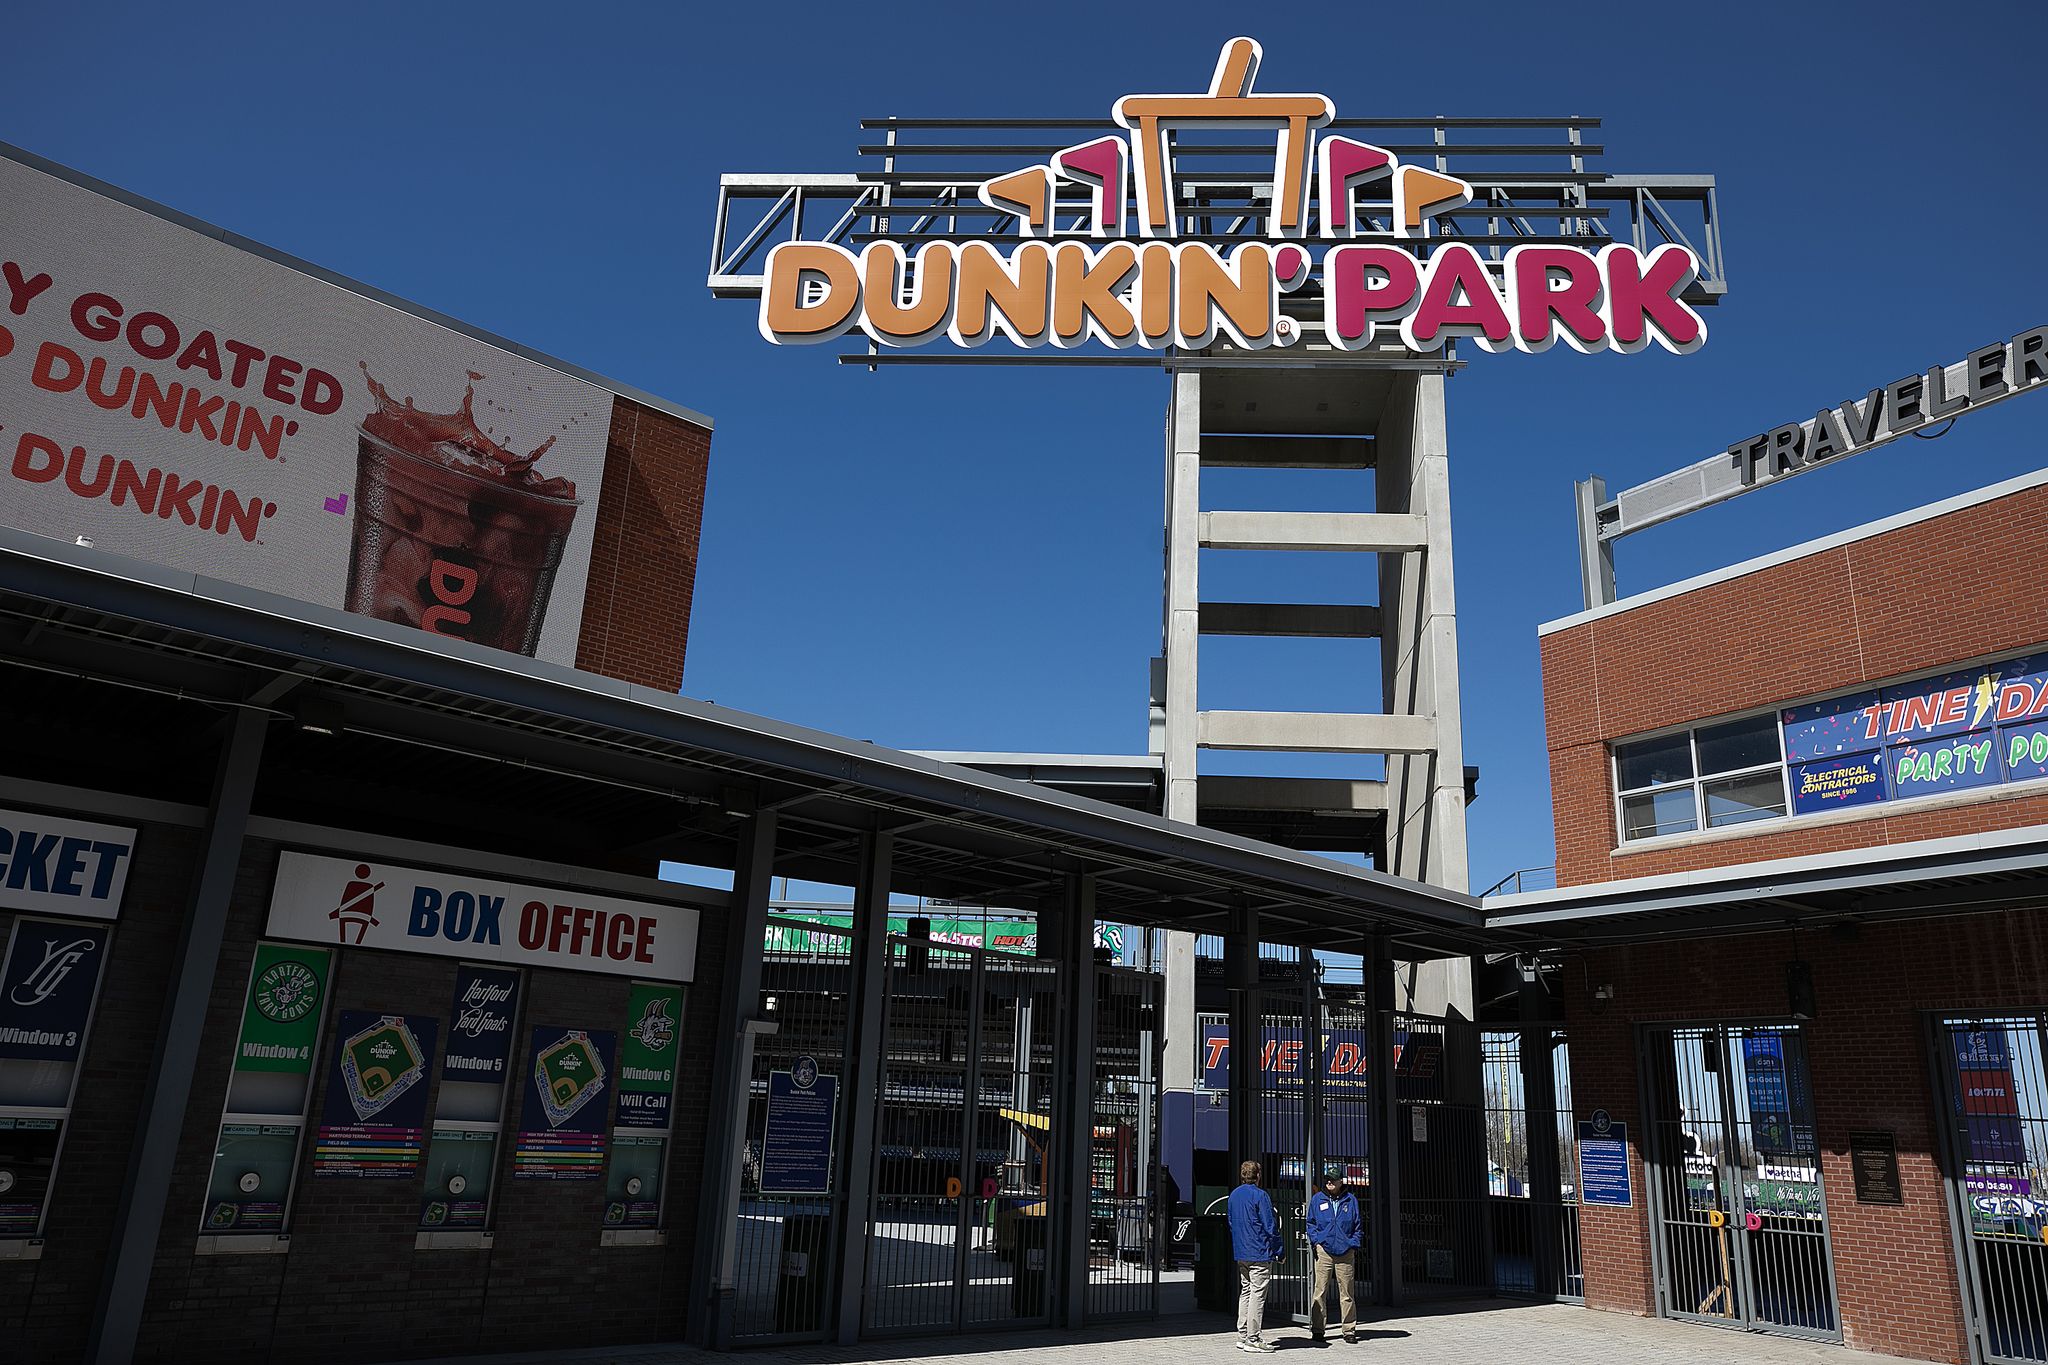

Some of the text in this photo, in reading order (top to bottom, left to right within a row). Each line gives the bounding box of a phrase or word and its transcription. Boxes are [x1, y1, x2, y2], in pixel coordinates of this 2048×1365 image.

[760, 239, 1708, 354] DUNKIN' PARK
[70, 292, 344, 415] GOATED
[31, 342, 300, 460] DUNKIN'
[1728, 325, 2048, 486] TRAVELER
[11, 432, 278, 543] DUNKIN'
[1863, 685, 1972, 739] TINE
[1896, 739, 1992, 785] PARTY
[1801, 773, 1877, 794] CONTRACTORS
[1806, 765, 1868, 783] ELECTRICAL
[1821, 790, 1841, 799] SINCE
[407, 885, 657, 963] BOX OFFICE
[993, 936, 1024, 946] HOT
[263, 964, 315, 988] HARTFORD
[461, 978, 514, 1008] Hartford
[258, 991, 314, 1019] YARD GOATS
[452, 1008, 483, 1031] Yard
[0, 1026, 77, 1047] Window 3
[242, 1042, 309, 1060] Window 4
[446, 1054, 503, 1072] Window 5
[622, 1066, 671, 1081] Window 6
[619, 1094, 667, 1108] Will Call
[1709, 1209, 1762, 1231] D D
